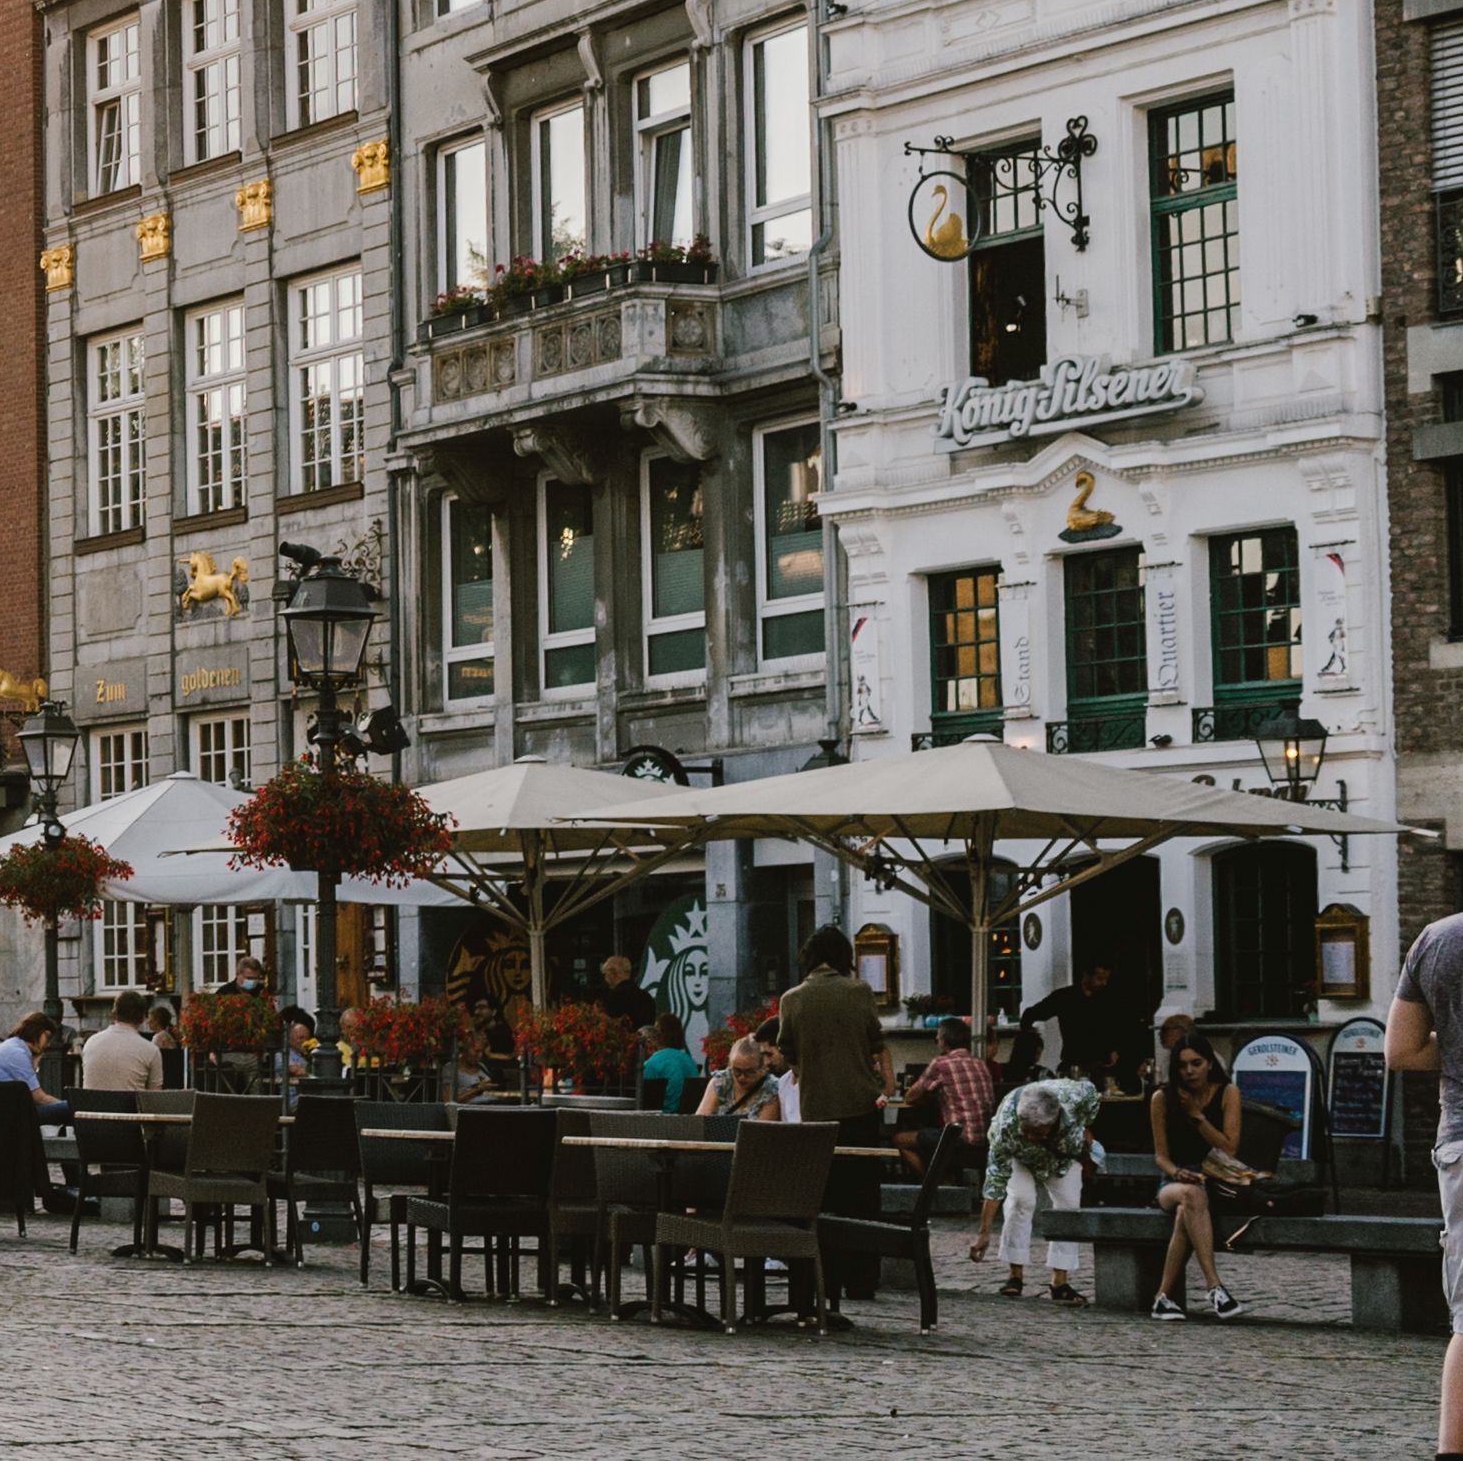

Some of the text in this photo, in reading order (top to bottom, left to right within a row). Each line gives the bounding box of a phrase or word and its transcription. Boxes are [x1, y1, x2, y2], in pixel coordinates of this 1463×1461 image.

[935, 358, 1192, 446] König-Pilsener
[1014, 636, 1031, 706] Stand
[1155, 590, 1179, 689] Quartier
[96, 666, 242, 704] Zum goldenen
[1247, 1043, 1299, 1057] GEROLSTEINER
